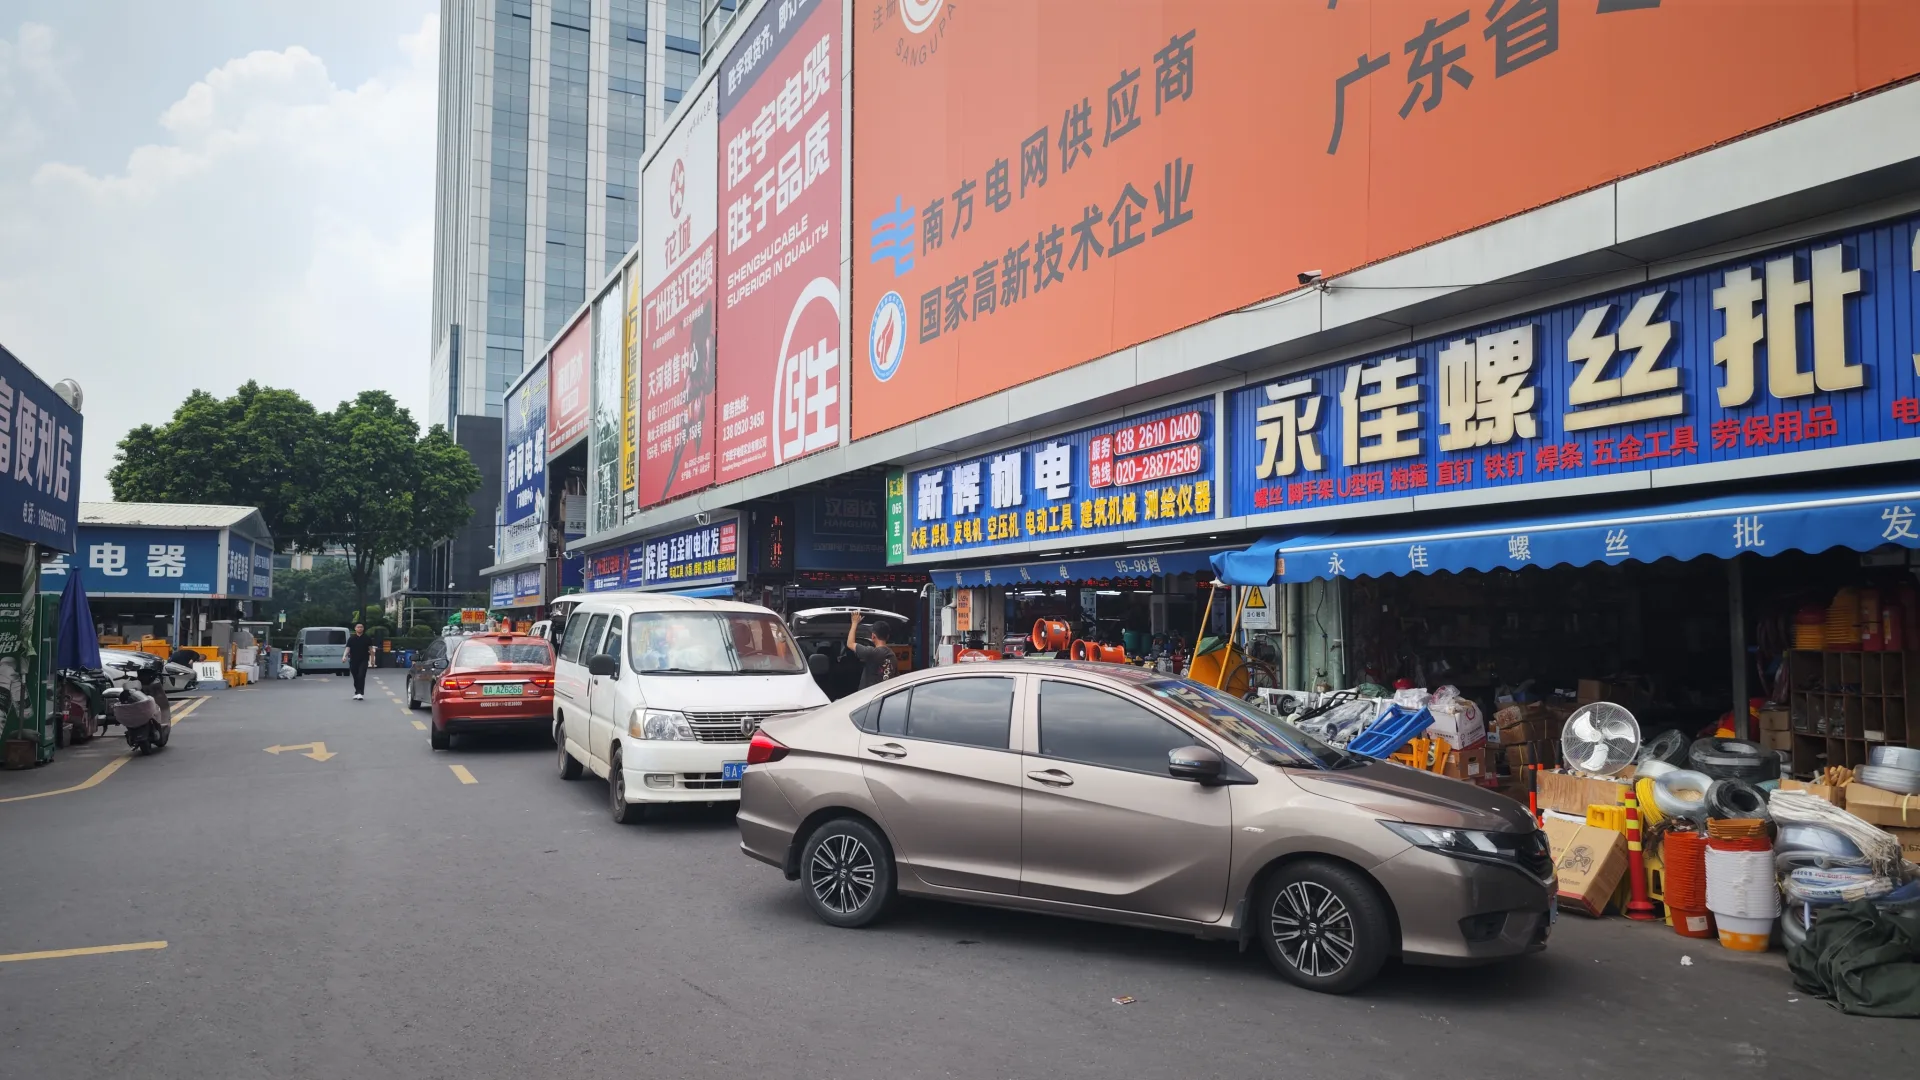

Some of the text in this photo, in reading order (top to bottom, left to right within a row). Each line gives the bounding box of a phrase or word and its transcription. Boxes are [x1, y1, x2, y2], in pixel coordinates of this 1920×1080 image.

[1326, 0, 1661, 155] 广东省
[727, 33, 831, 192] 胜宇电缆
[922, 28, 1197, 257] 南方电网供应商
[727, 111, 831, 256] 胜于品质
[727, 220, 829, 309] SUPERIOR IN QUALITY
[919, 157, 1195, 345] 国家高新技术企业
[647, 342, 699, 400] 天河销售中心
[1255, 228, 1920, 481] 永佳螺丝批
[722, 424, 734, 442] 138
[1091, 436, 1111, 460] 服务
[1116, 412, 1200, 453] 138 2610 0400
[1253, 487, 1284, 509] 螺丝
[1287, 478, 1334, 504] 脚手架
[1336, 470, 1384, 498] U型码
[1390, 464, 1428, 491] 抱箍
[1436, 458, 1474, 487] 直钉
[1484, 450, 1526, 479] 铁钉
[1535, 442, 1583, 473] 焊条
[1590, 426, 1698, 467] 五金工具
[1711, 405, 1838, 450] 劳保用品
[917, 442, 1071, 521] 新辉机电
[1091, 461, 1111, 485] 热线
[1115, 447, 1200, 484] 020-28872509
[893, 520, 901, 537] 至
[911, 479, 1212, 549] 水泵 焊机 发电机 空压机 电动工具 建筑机械 测绘仪器
[645, 541, 669, 580] 辉煌
[669, 527, 720, 563] 五金机电批发
[891, 543, 902, 556] 123
[1115, 556, 1161, 574] 95-98档
